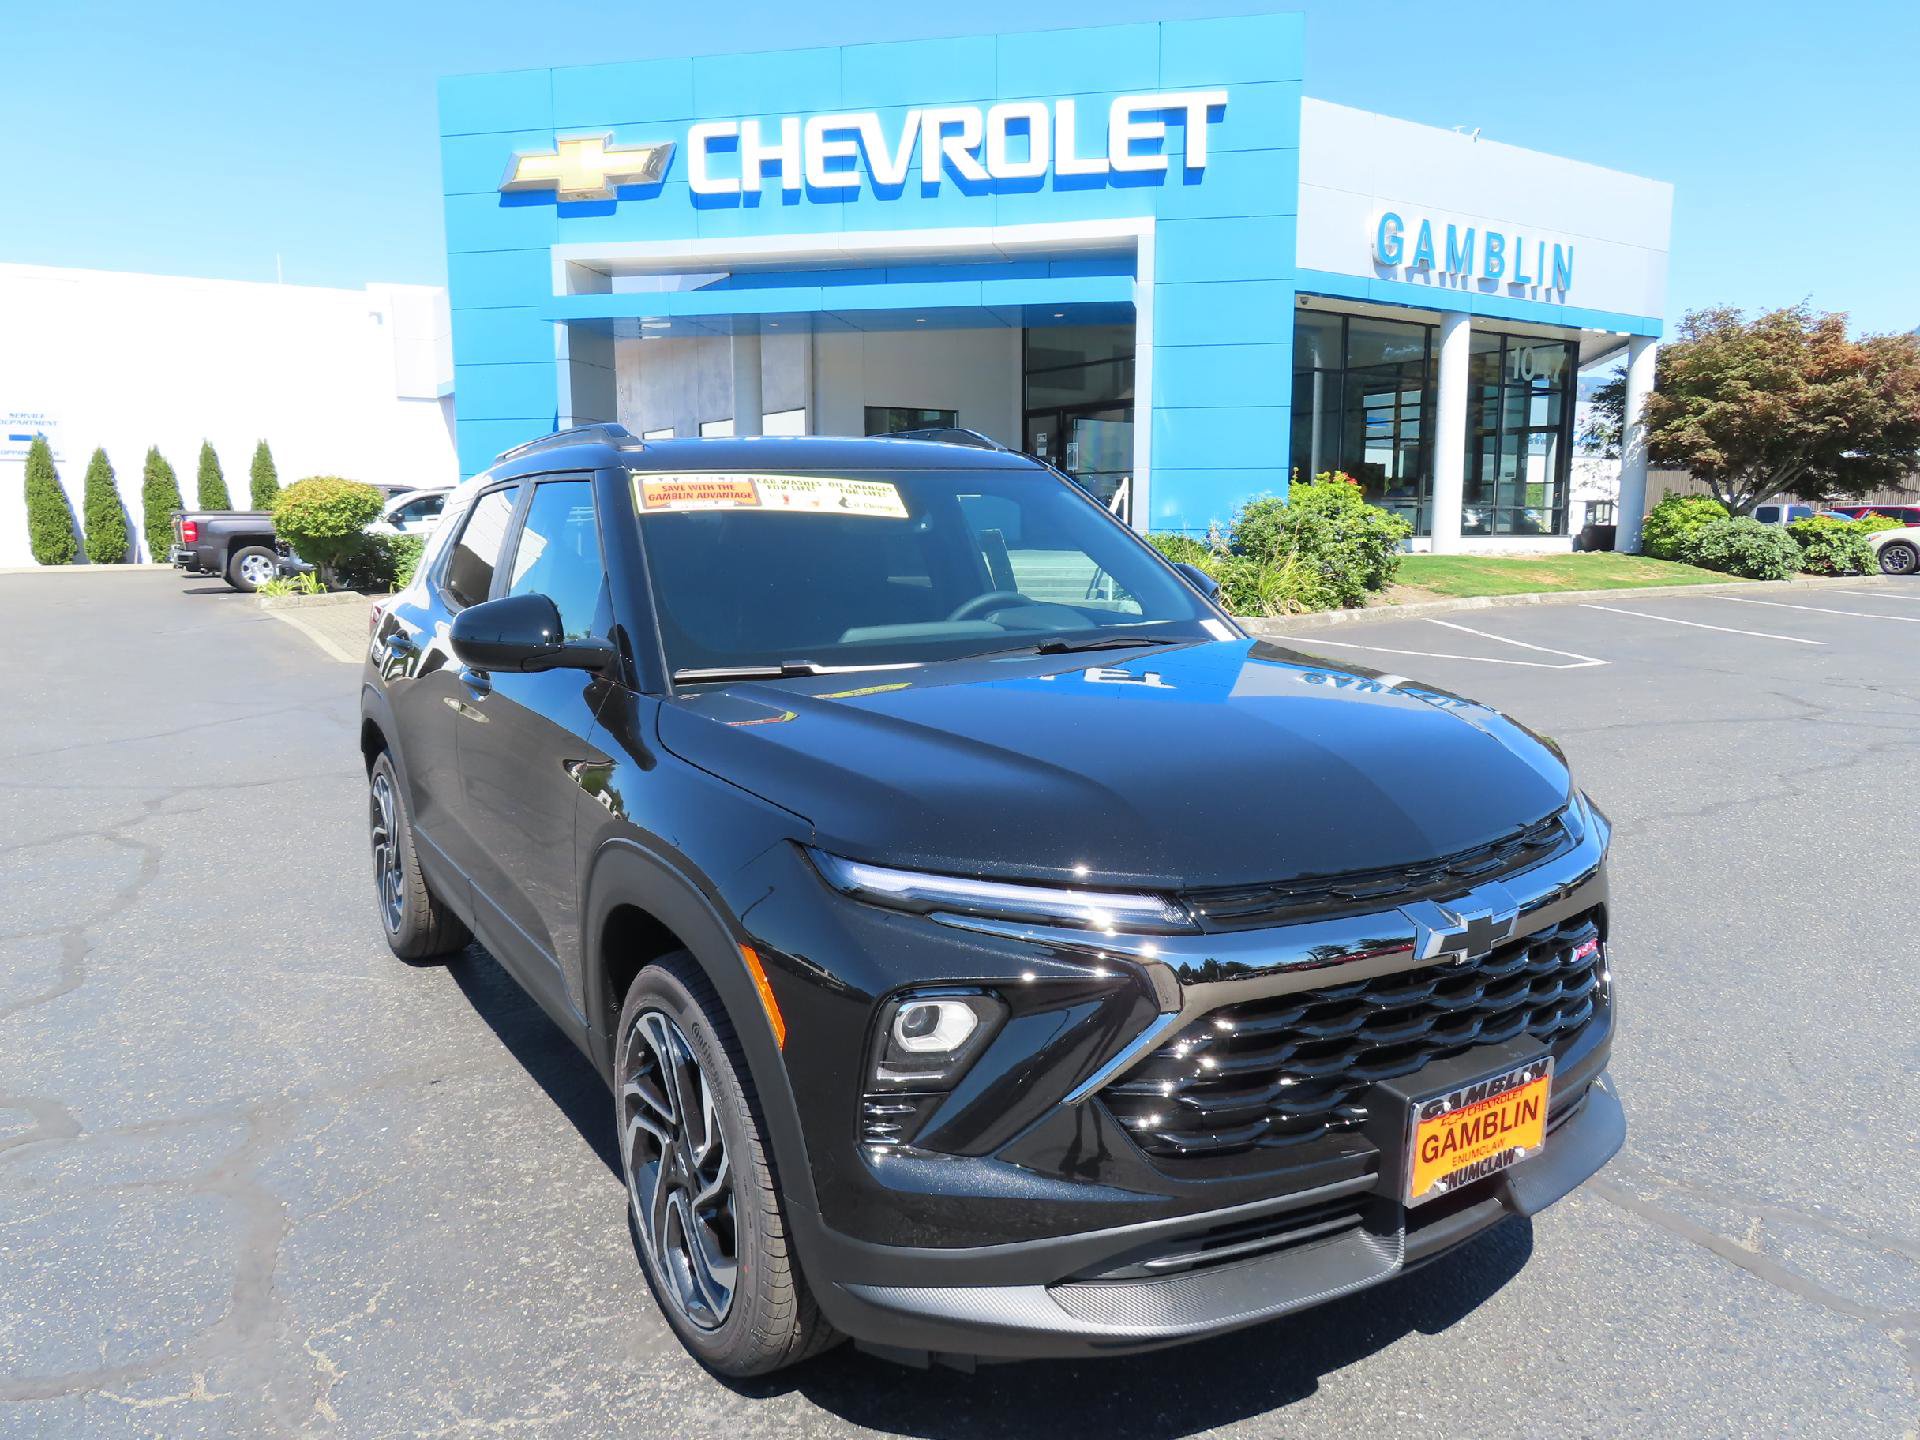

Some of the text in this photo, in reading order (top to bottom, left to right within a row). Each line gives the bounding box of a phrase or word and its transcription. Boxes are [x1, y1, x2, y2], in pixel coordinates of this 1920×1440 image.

[687, 90, 1228, 195] CHEVROLET
[1377, 212, 1574, 291] GAMBLIN
[648, 492, 753, 502] GAMBLIN ADVANTAGE
[661, 484, 686, 492] SAVE
[1467, 1089, 1524, 1117] CHEVROLET
[1421, 1096, 1539, 1163] GAMBLIN
[1452, 1138, 1505, 1167] ENUMCLAW
